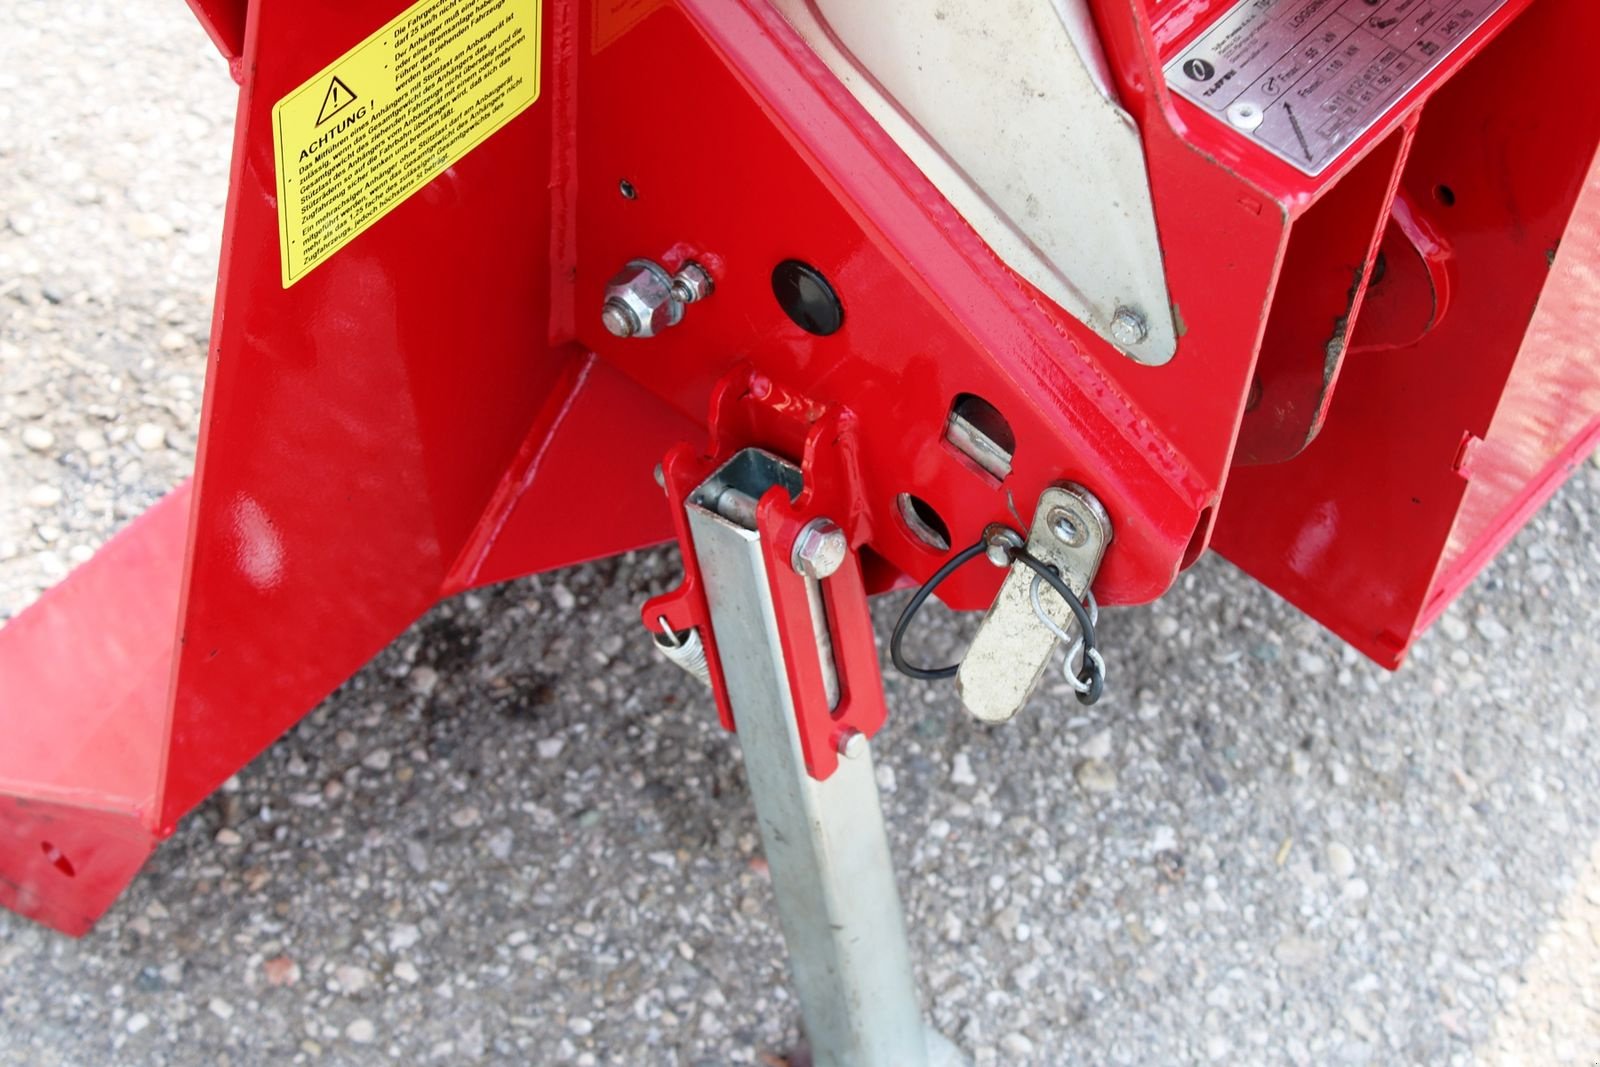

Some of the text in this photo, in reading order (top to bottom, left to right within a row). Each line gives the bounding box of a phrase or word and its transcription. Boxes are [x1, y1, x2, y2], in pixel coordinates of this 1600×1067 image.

[394, 0, 457, 48] darf 25 km/h nicht
[394, 26, 406, 38] Die
[395, 0, 475, 61] Der Anhänger muß eine
[395, 56, 411, 72] oder
[413, 45, 428, 59] eine
[429, 11, 474, 47] Bremsanlage
[395, 62, 418, 82] Führer
[420, 51, 433, 64] des
[434, 25, 469, 54] ziehenden
[299, 12, 514, 175] Das Mitführen eines Anhängers mit Stützlast am Anbaugerät ist
[300, 27, 522, 194] Gesamtgewicht des ziehenden Fahrzeugs nicht übersteigt und die
[300, 35, 526, 205] Stützlast des Anhängers vom Anbaugerät mit einem oder mehreren
[333, 143, 352, 160] wenn
[353, 133, 366, 146] das
[368, 91, 421, 134] Gesamtgewicht
[423, 82, 435, 95] des
[437, 54, 473, 84] Anhängers
[475, 44, 487, 56] das
[395, 70, 421, 92] werden
[299, 106, 366, 163] ACHTUNG
[301, 181, 342, 215] Stützrädern
[344, 174, 352, 183] so
[354, 162, 365, 175] auf
[367, 155, 378, 166] die
[379, 129, 412, 157] Fahrbahn
[413, 101, 450, 132] übertragen
[470, 76, 482, 90] daß
[484, 66, 498, 79] sich
[499, 56, 511, 68] das
[301, 188, 346, 225] Zugfahrzeug
[347, 171, 369, 190] sicher
[370, 153, 393, 173] lenken
[395, 140, 408, 155] und
[409, 119, 439, 144] bremsen
[302, 75, 513, 236] Ein mehrachsiger Anhänger ohne Stützlast darf am Anbaugerät
[302, 214, 339, 246] mitgeführt
[369, 179, 388, 196] wenn
[389, 169, 402, 181] das
[403, 128, 455, 170] Gesamtgewicht
[456, 119, 468, 131] des
[470, 92, 505, 121] Anhängers
[506, 77, 523, 94] nicht
[303, 102, 504, 255] mehr als das 1,25 fache des zulässigen Gesamtgewichts des
[354, 206, 378, 229] jedoch
[379, 179, 414, 208] höchstens
